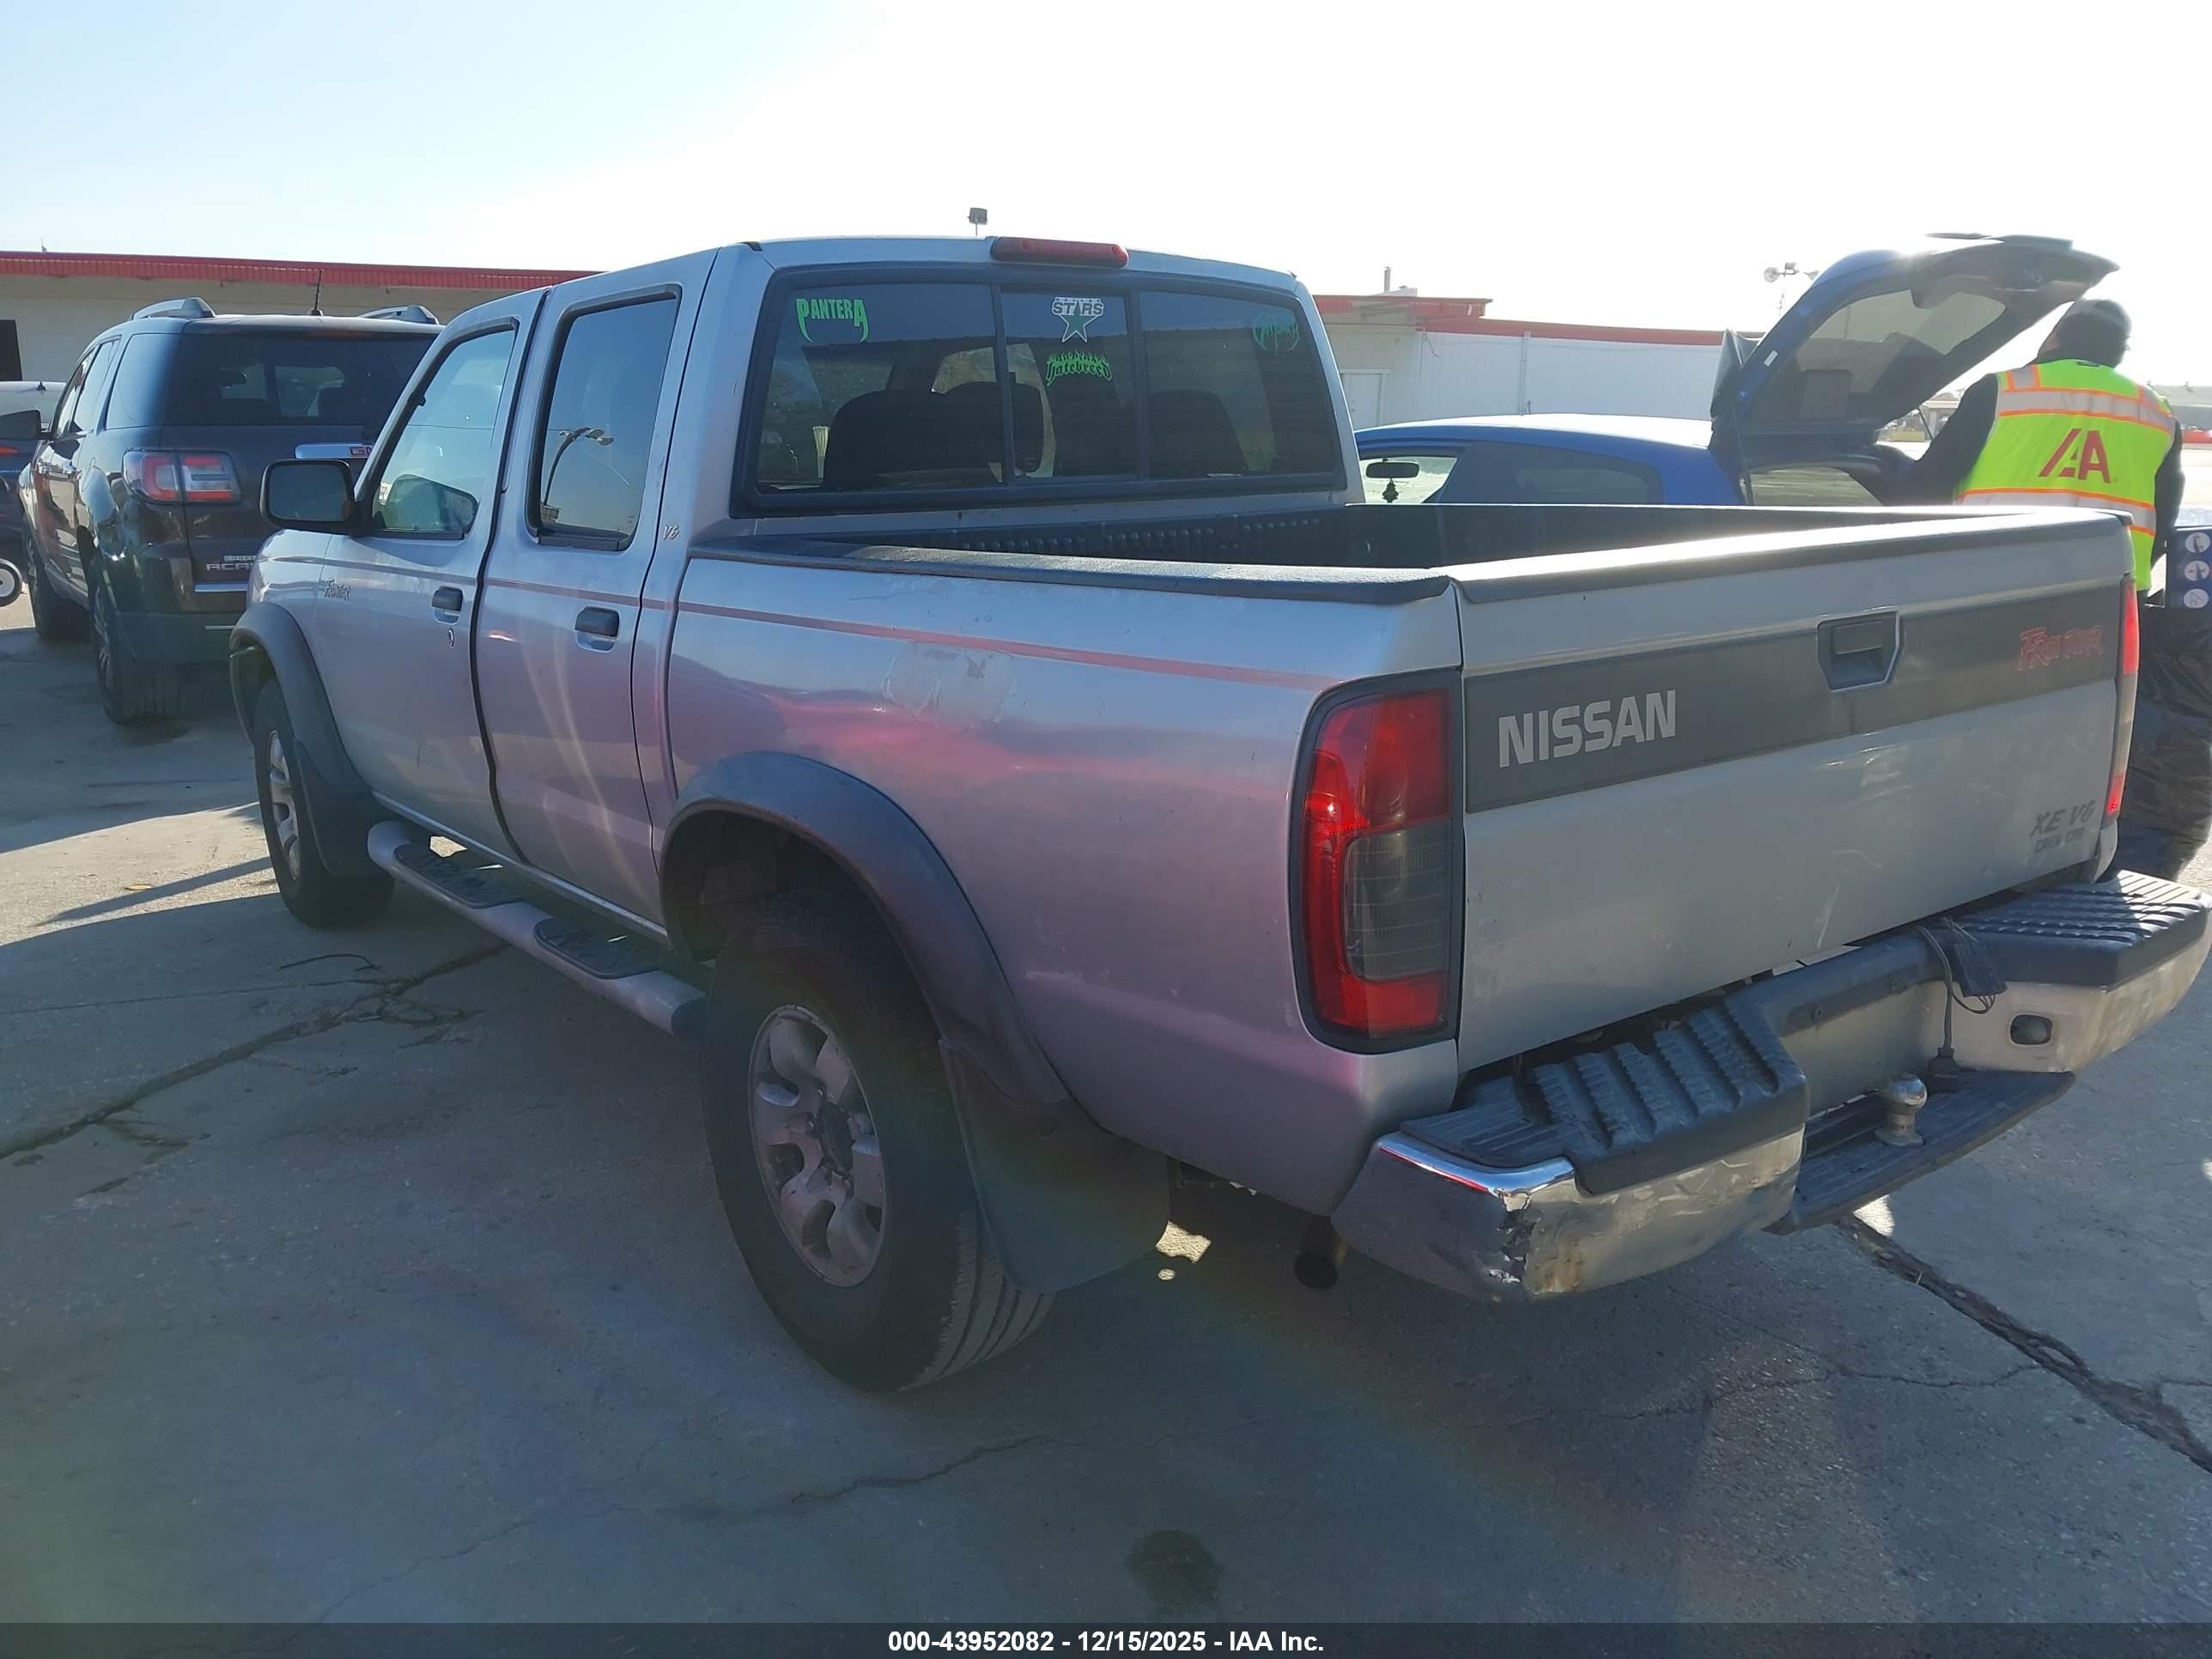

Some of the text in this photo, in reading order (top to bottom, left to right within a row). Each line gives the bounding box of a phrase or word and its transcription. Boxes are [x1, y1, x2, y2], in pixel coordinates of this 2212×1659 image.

[796, 298, 869, 343] PANTERA
[1052, 301, 1104, 316] STARS
[1498, 690, 1676, 769] NISSAN
[2029, 799, 2096, 838] XE V6
